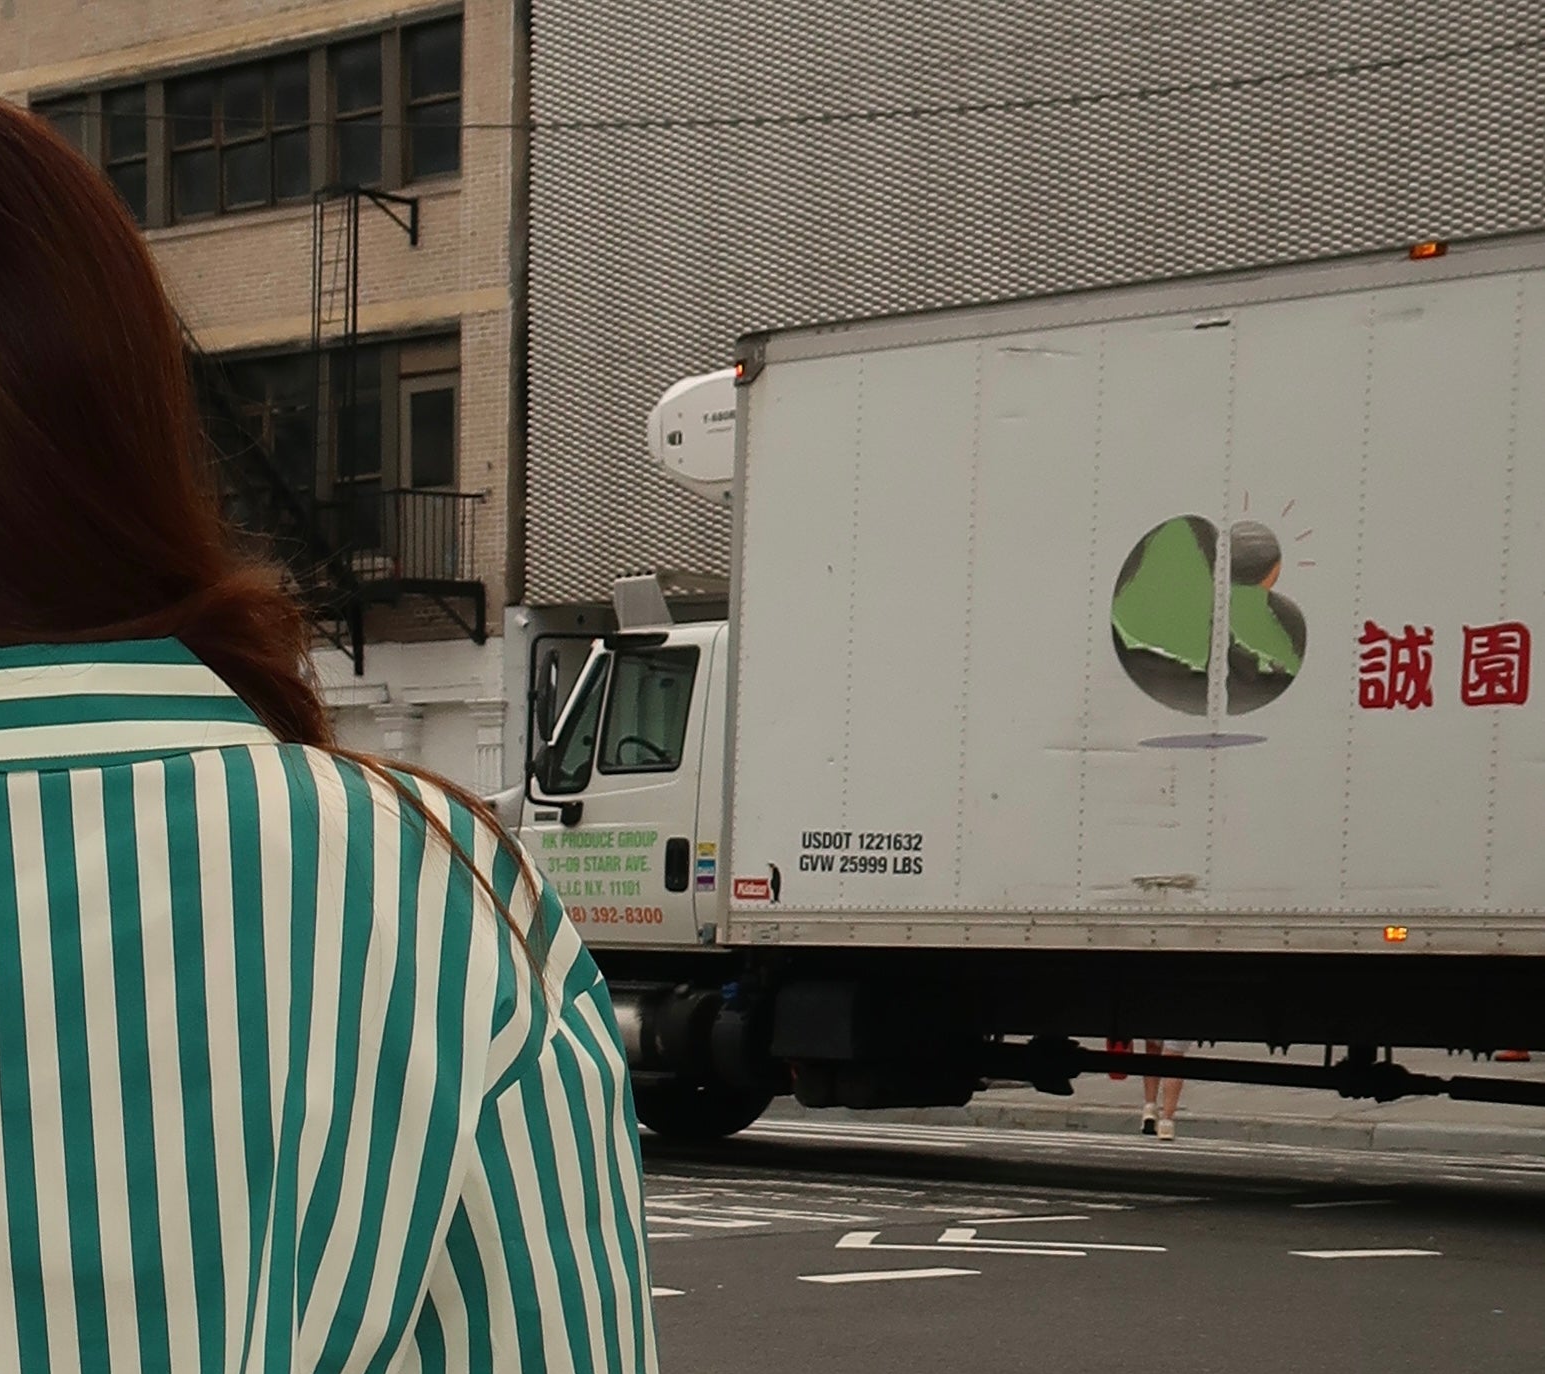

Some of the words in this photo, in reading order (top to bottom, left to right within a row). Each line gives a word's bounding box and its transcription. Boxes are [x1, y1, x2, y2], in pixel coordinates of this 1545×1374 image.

[1358, 620, 1531, 709] 誠園
[561, 831, 614, 848] PRODUCE
[618, 830, 658, 848] GROUP
[801, 831, 852, 849] USDOT
[858, 833, 923, 851] 1221632
[583, 855, 621, 872] STARR
[799, 854, 835, 872] GVW
[839, 856, 888, 873] 25999
[892, 857, 923, 875] LBS
[609, 880, 641, 896] 11101
[591, 906, 663, 924] 392-8300
